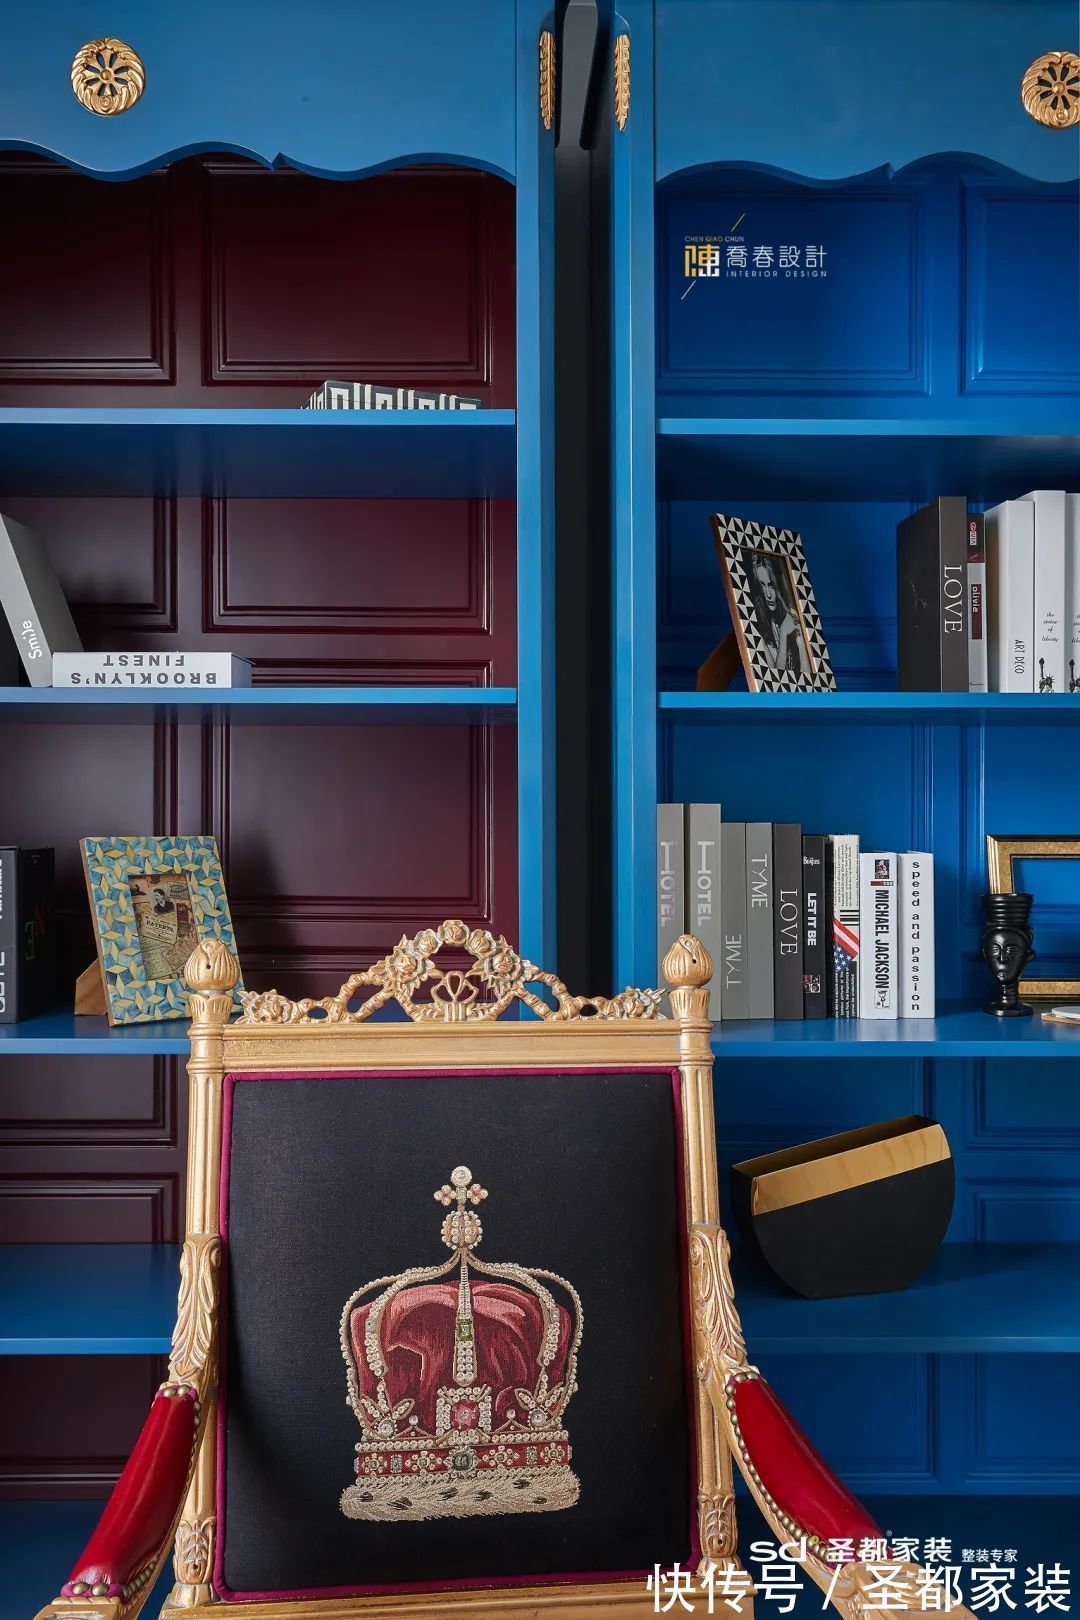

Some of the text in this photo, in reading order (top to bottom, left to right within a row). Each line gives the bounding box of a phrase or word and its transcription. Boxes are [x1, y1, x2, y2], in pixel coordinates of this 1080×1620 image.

[943, 565, 963, 633] LOVE
[22, 620, 43, 660] Smile
[103, 654, 185, 667] FINEST
[1014, 639, 1025, 653] ART
[70, 672, 217, 685] BROOKLYN'S
[660, 841, 677, 927] HOTEL
[697, 840, 715, 926] HOTEL
[751, 853, 768, 908] TYME
[780, 889, 798, 955] LOVE
[807, 892, 817, 946] LET IT BE
[874, 889, 890, 937] MICHAEL
[911, 861, 921, 1011] speed and passion
[725, 934, 743, 989] TYME
[874, 939, 890, 989] JACKSON
